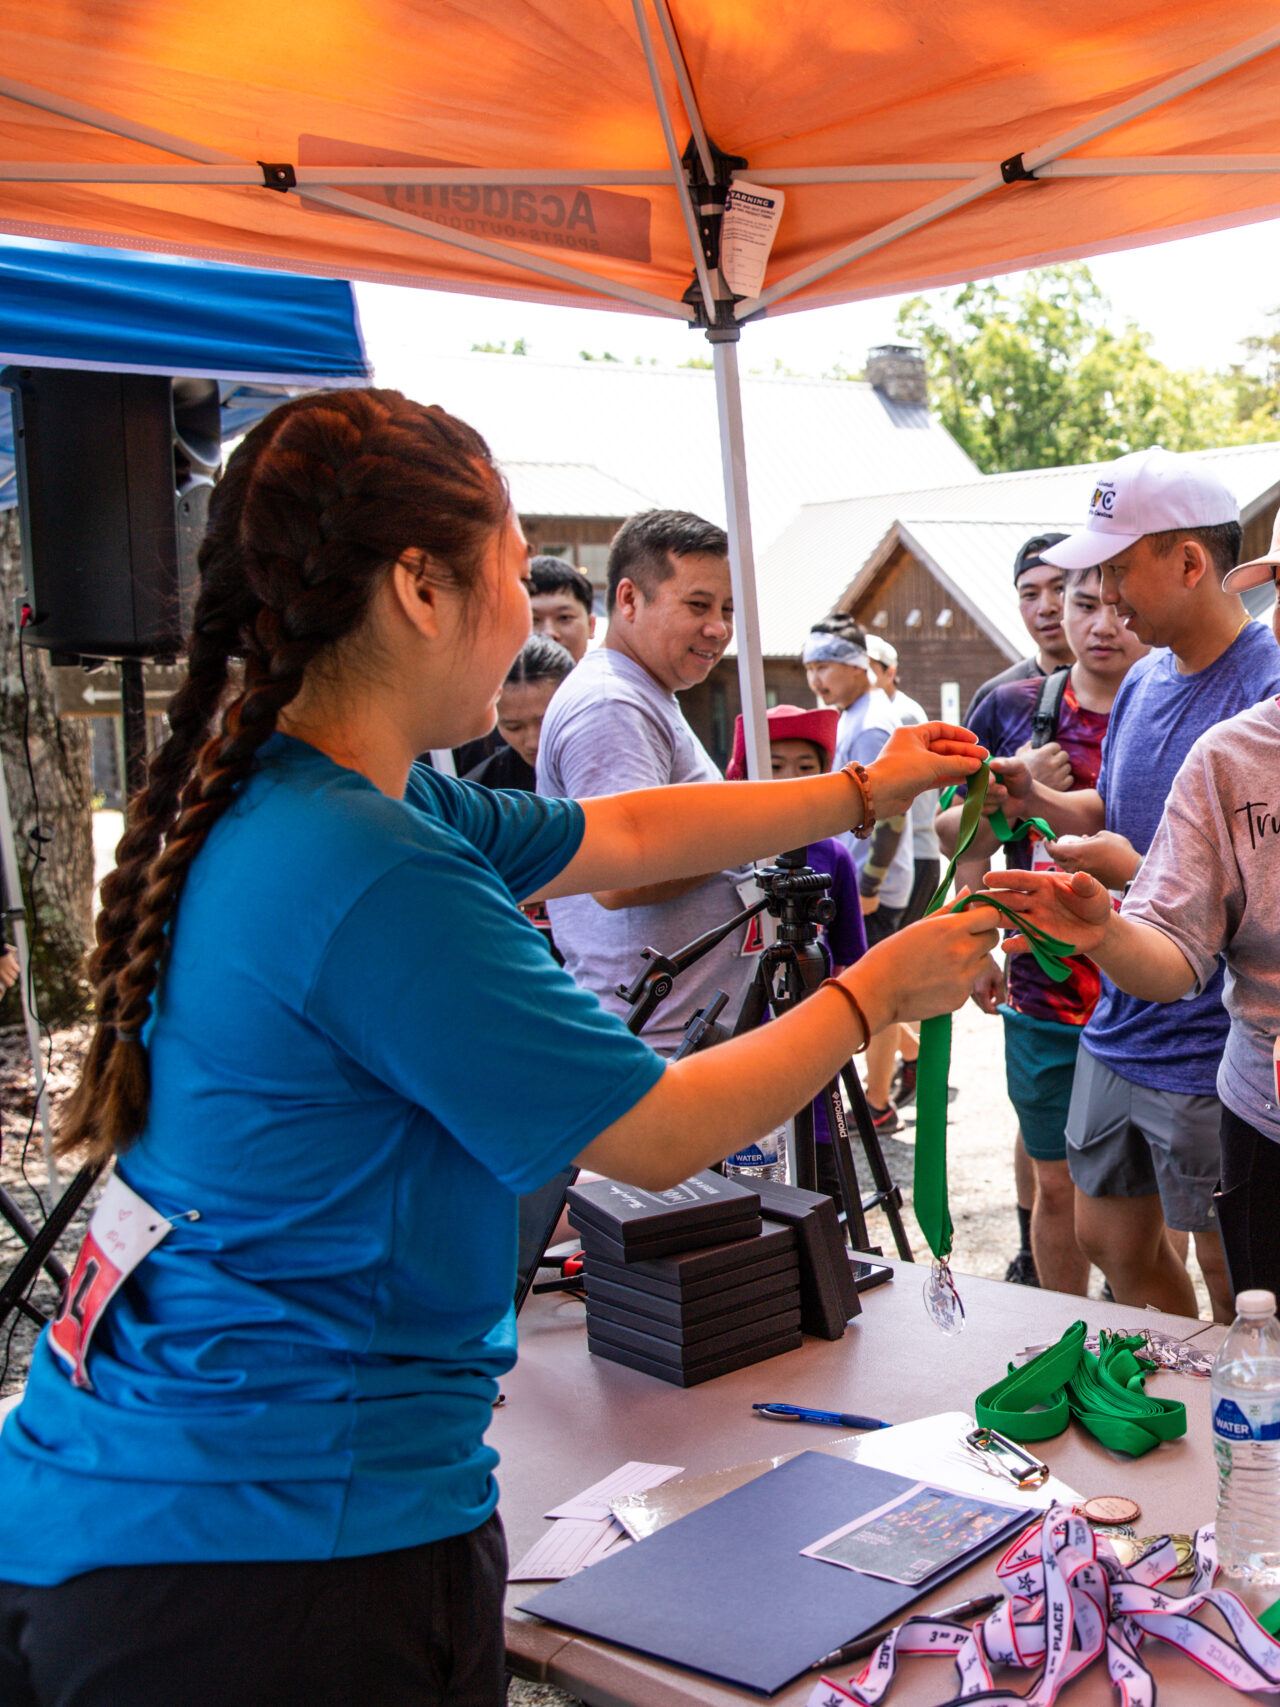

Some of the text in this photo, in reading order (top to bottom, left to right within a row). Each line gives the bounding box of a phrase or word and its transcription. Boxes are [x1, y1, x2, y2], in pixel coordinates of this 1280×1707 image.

[832, 1100, 848, 1138] Polaroid
[736, 1154, 762, 1162] WATER
[1215, 1418, 1249, 1435] WATER
[1052, 1602, 1064, 1651] PLACE
